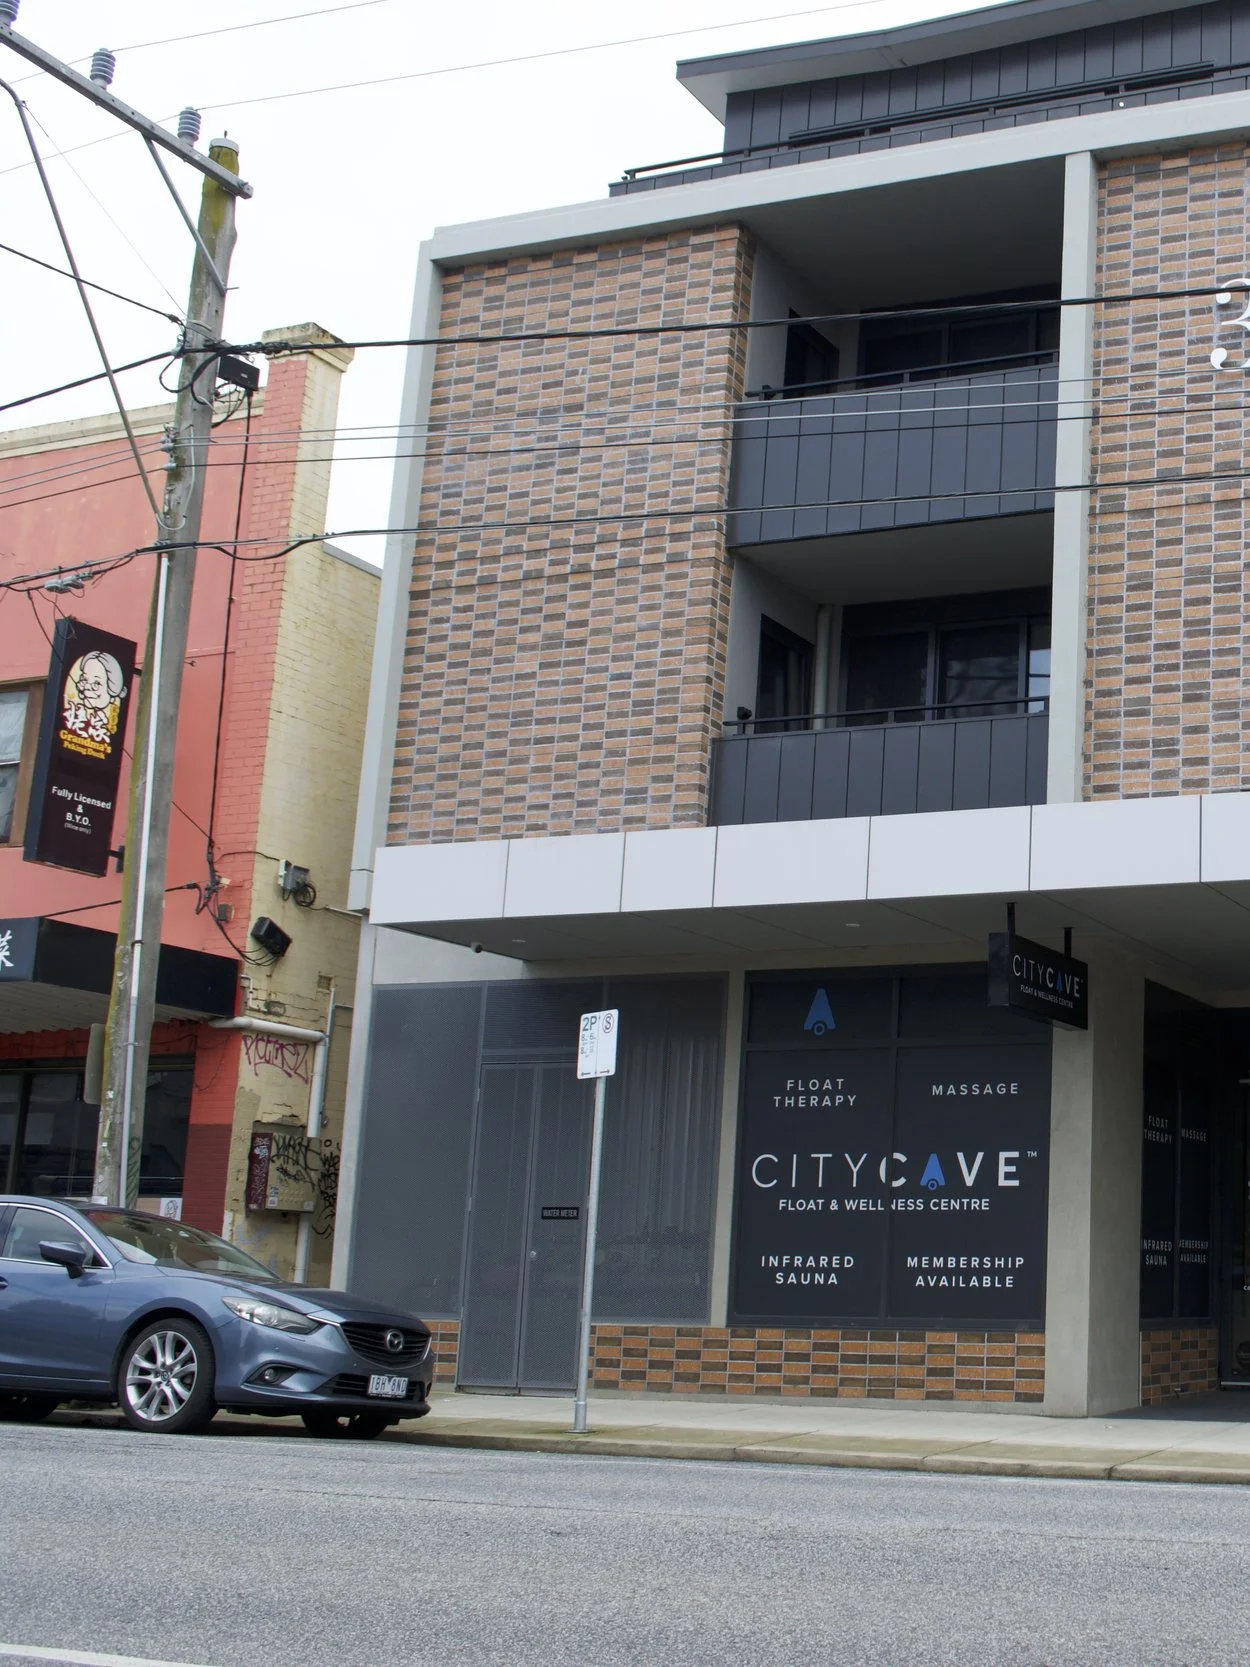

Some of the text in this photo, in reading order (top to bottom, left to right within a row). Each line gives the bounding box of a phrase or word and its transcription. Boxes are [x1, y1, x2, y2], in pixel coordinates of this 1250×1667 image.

[59, 729, 112, 753] Grandma's
[51, 786, 112, 809] Fully Licensed
[76, 804, 83, 813] &
[65, 812, 91, 826] B.Y.O.
[582, 1015, 597, 1032] 2P
[787, 1078, 845, 1091] FLOAT
[932, 1082, 1020, 1096] MASSAGE
[773, 1094, 857, 1108] THERAPY
[1148, 1115, 1168, 1129] FLOAT
[1144, 1129, 1172, 1144] THERAPY
[779, 1199, 824, 1211] FLOAT
[829, 1199, 839, 1210] &
[930, 1198, 991, 1210] CENTRE
[762, 1256, 855, 1268] INFRARED
[907, 1257, 1025, 1269] MEMBERSHIP
[1145, 1254, 1167, 1265] SAUNA
[775, 1272, 838, 1285] SAUNA
[915, 1275, 1014, 1287] AVAILABLE
